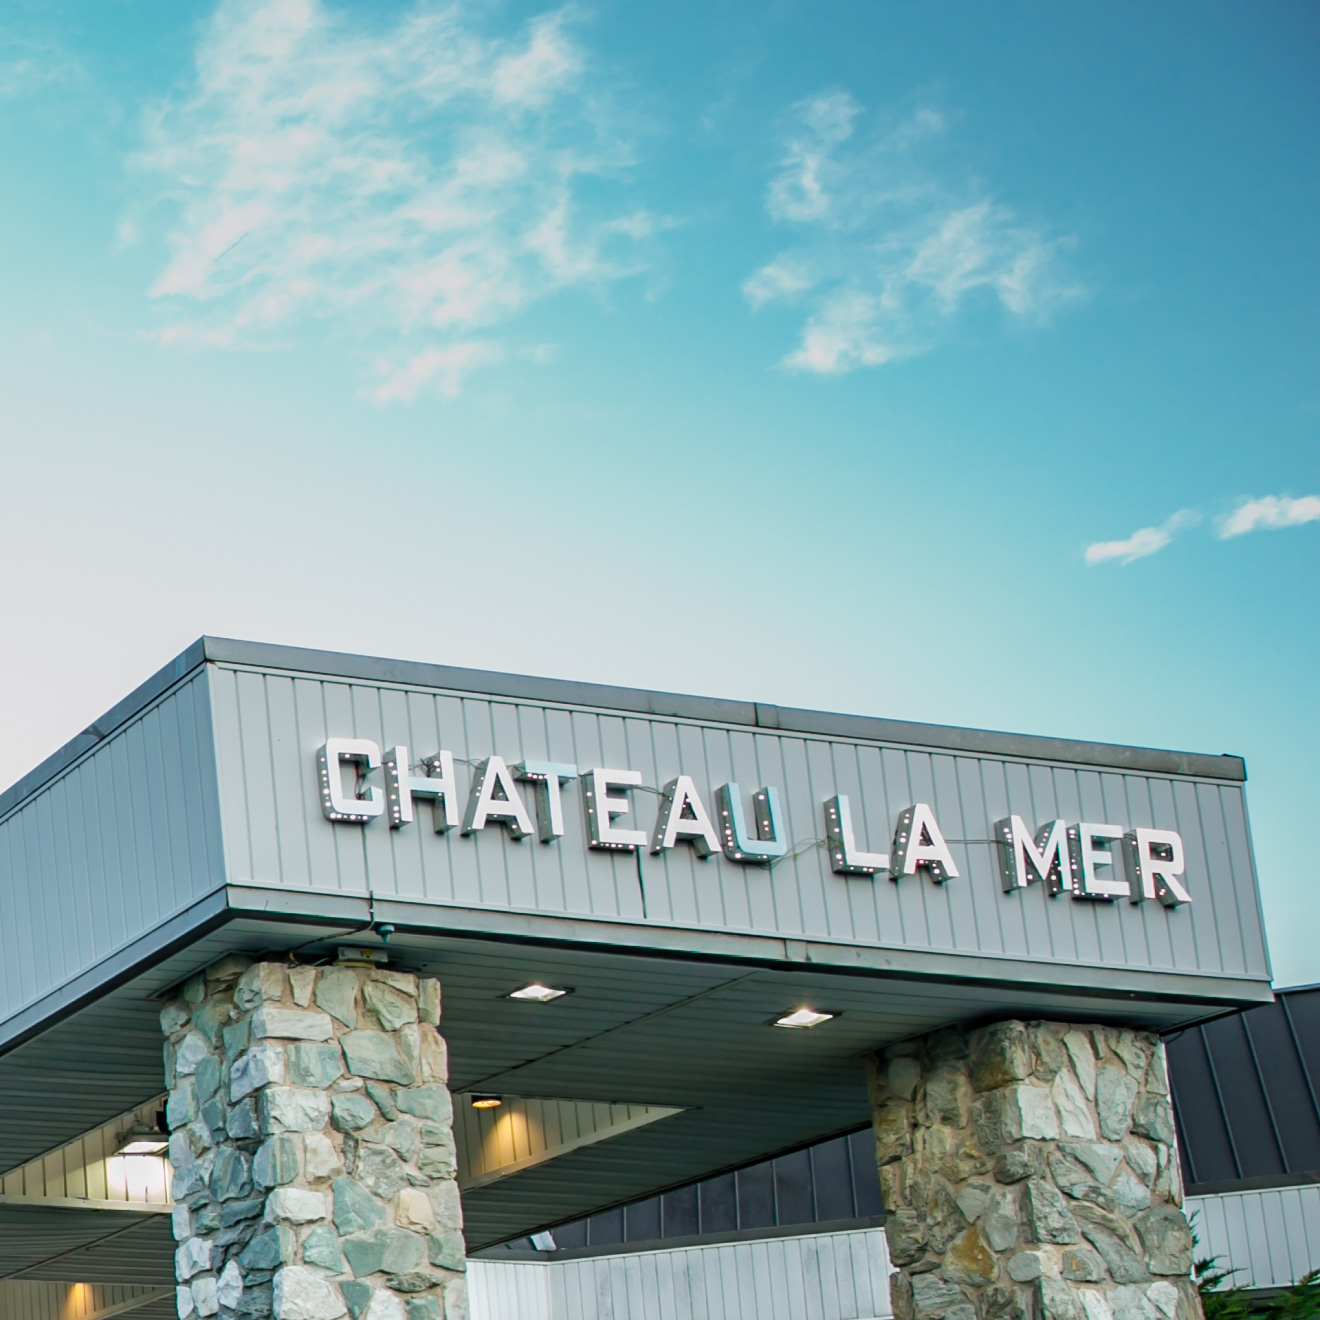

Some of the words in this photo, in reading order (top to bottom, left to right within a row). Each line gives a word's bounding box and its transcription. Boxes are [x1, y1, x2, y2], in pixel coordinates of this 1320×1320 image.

[317, 738, 787, 864] CHATEAU
[823, 794, 959, 885] LA
[994, 815, 1192, 908] MER
